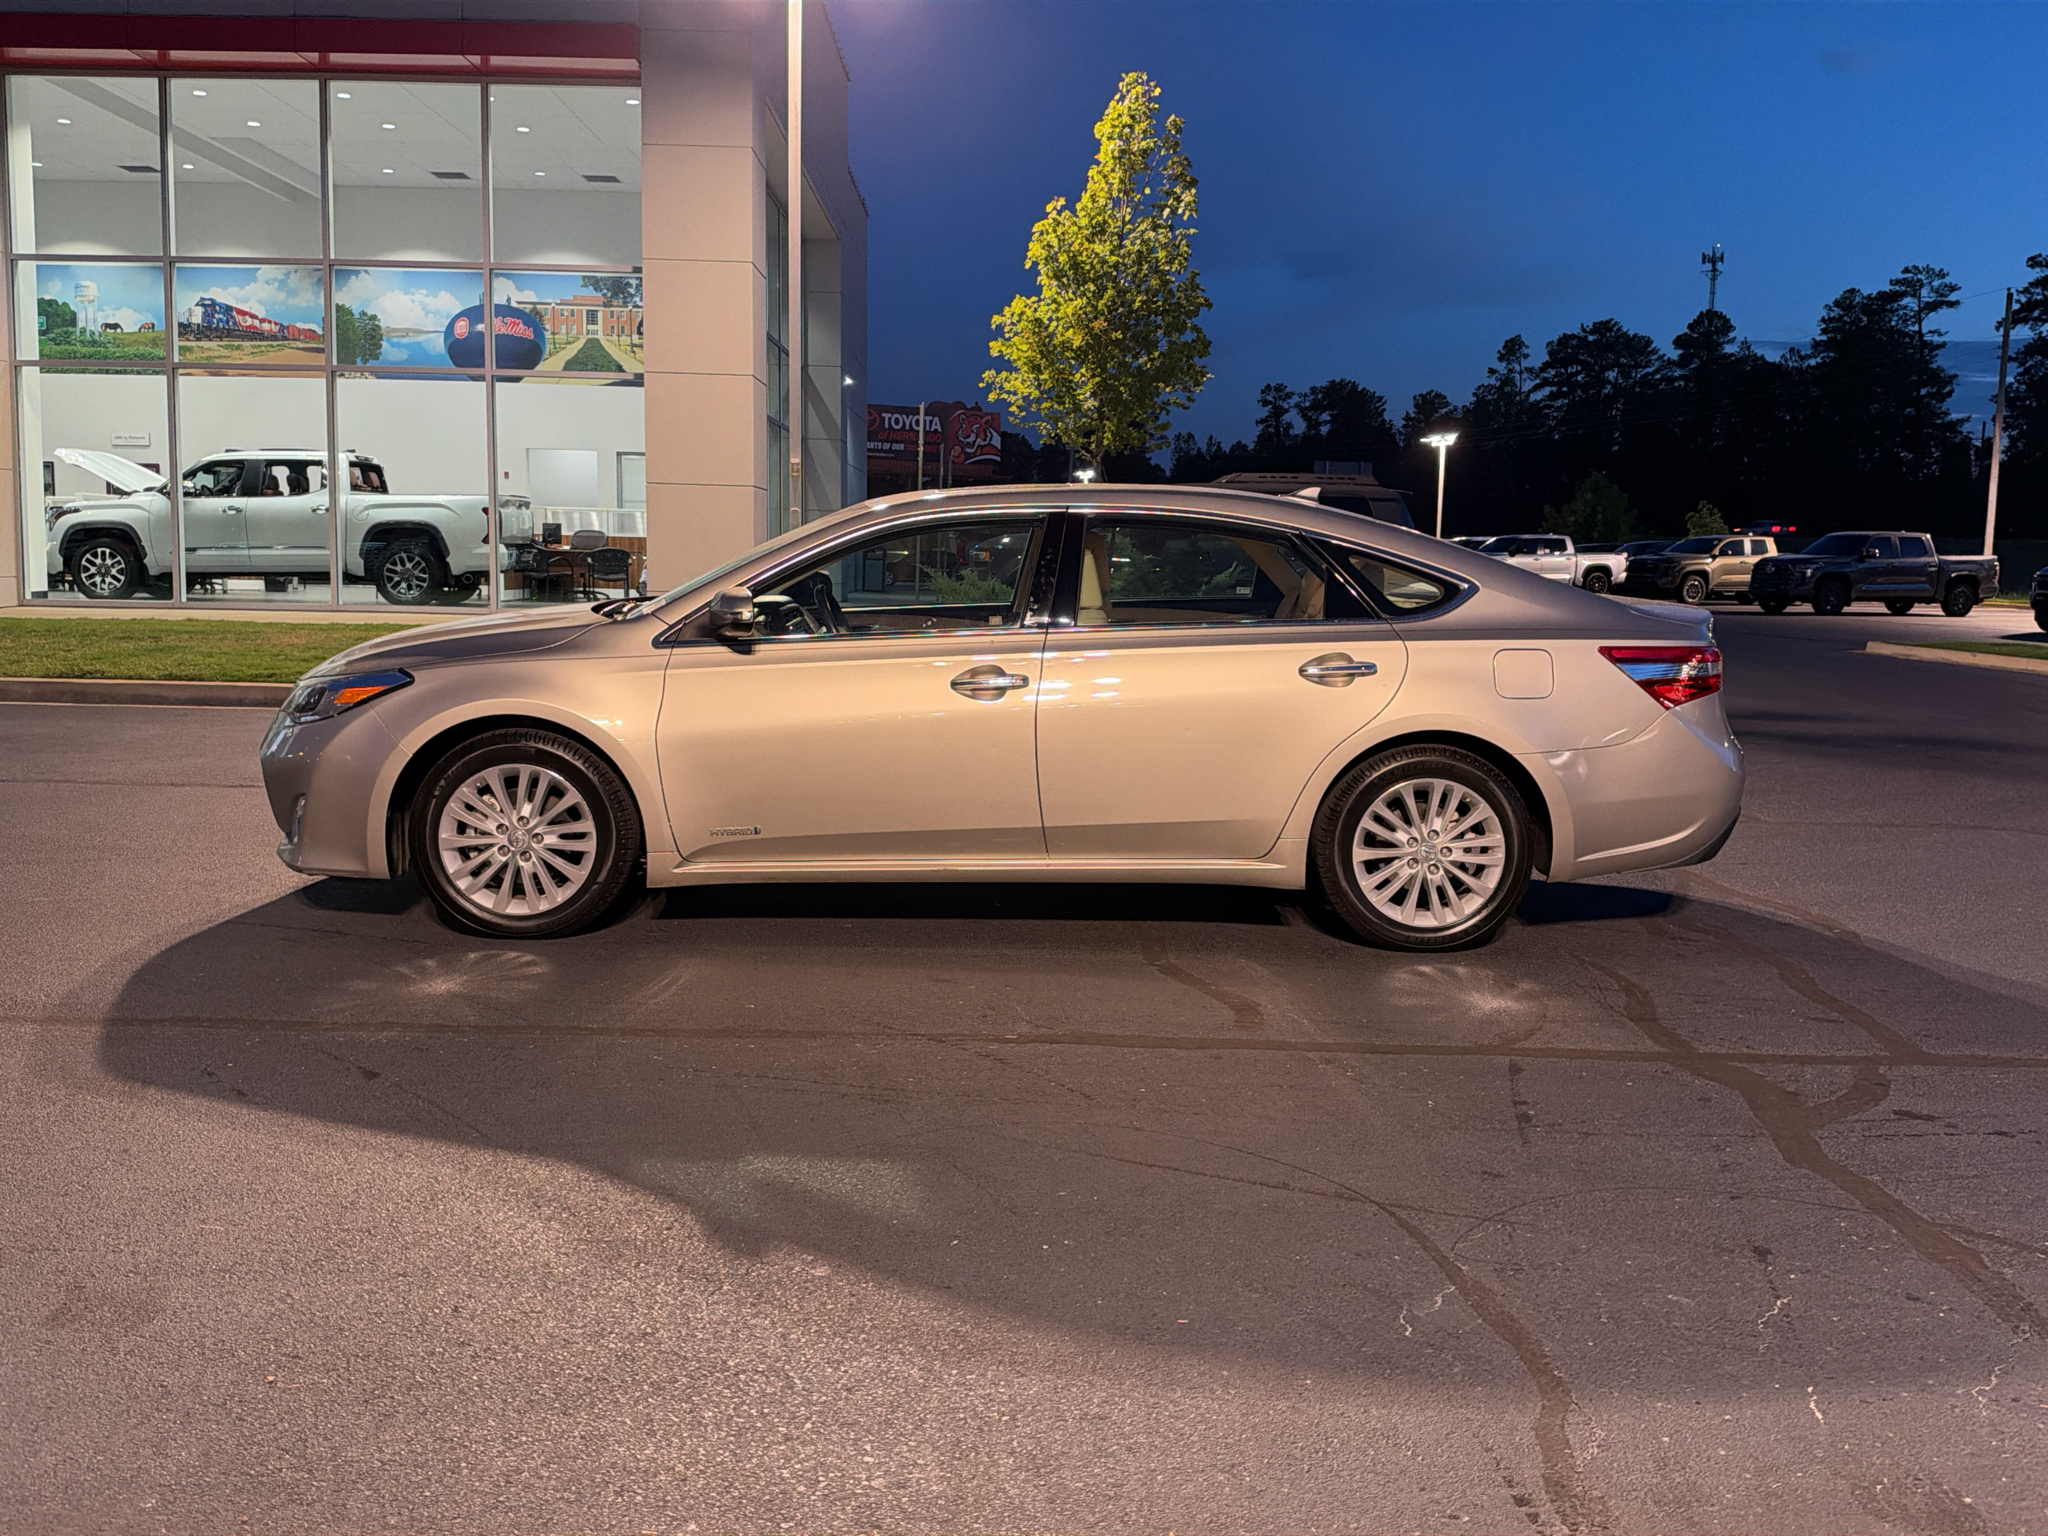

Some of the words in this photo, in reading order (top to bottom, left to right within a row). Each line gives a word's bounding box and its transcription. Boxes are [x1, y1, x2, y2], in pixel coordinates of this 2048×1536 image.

[504, 317, 534, 340] Miss
[882, 413, 942, 432] TOYOTA
[878, 431, 889, 440] of
[889, 431, 942, 443] HERNNDO
[867, 441, 882, 449] ANTS
[882, 442, 891, 450] OF
[891, 443, 905, 451] OUR
[710, 826, 753, 837] HYBRID
